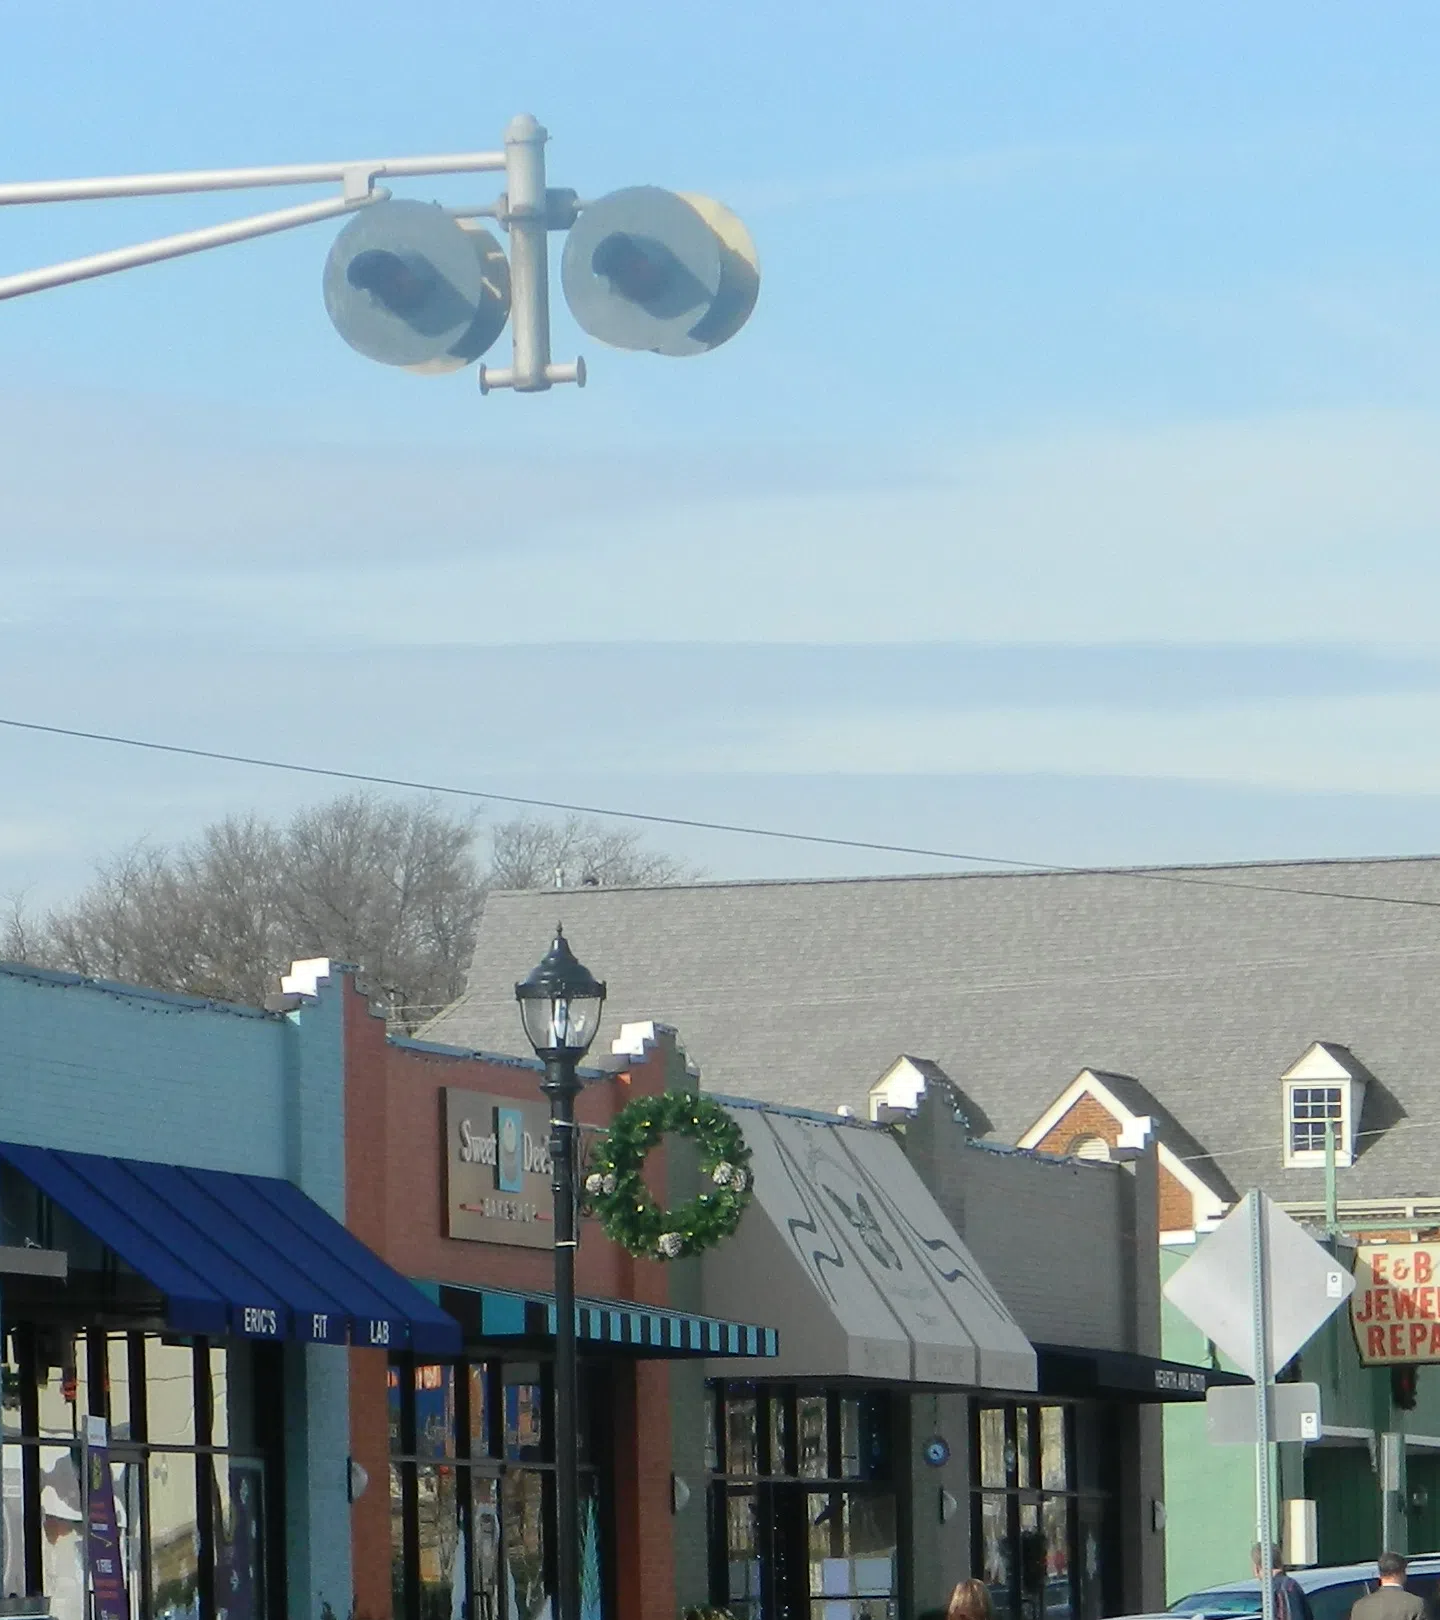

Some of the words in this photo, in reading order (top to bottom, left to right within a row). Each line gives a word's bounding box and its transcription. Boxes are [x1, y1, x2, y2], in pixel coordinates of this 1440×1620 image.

[460, 1118, 497, 1166] Sweet
[244, 1307, 277, 1335] ERIC'S
[313, 1314, 328, 1339] FIT
[370, 1320, 389, 1344] LAB
